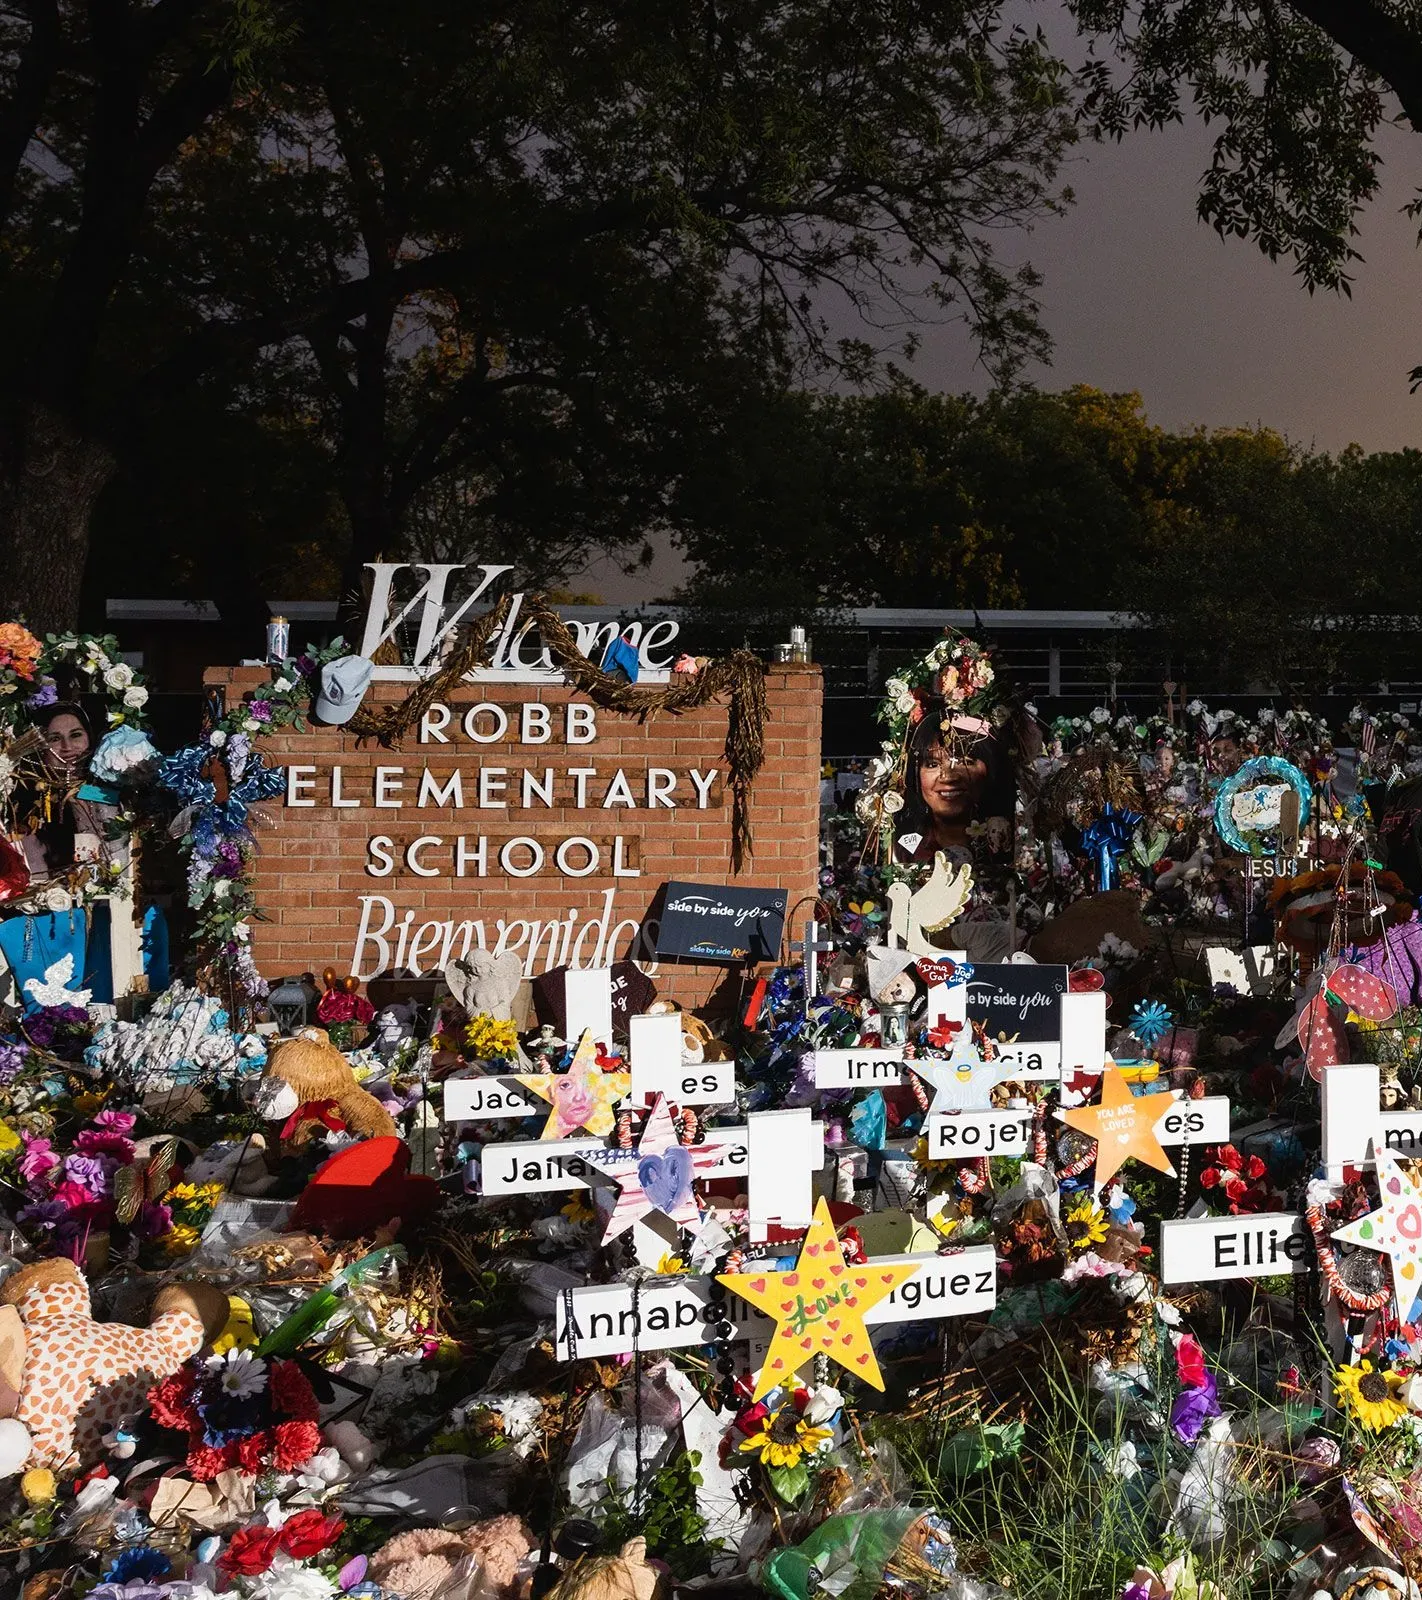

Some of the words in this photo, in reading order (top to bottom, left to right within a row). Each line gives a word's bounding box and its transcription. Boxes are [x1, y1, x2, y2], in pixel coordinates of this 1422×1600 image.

[361, 563, 679, 670] Wlcome
[421, 703, 597, 744] ROBB
[287, 766, 718, 809] ELEMENTARY
[367, 836, 640, 878] SCHOOL
[667, 900, 692, 913] side
[694, 907, 708, 917] by
[710, 902, 735, 917] side
[978, 992, 991, 1008] by
[993, 986, 1017, 1006] side
[1019, 992, 1053, 1021] you
[848, 1058, 909, 1080] Irm
[470, 1089, 547, 1112] Jack
[1096, 1107, 1117, 1121] YOU
[1118, 1103, 1137, 1116] ARE
[939, 1121, 1028, 1152] Rojel
[1101, 1118, 1137, 1132] LOVED
